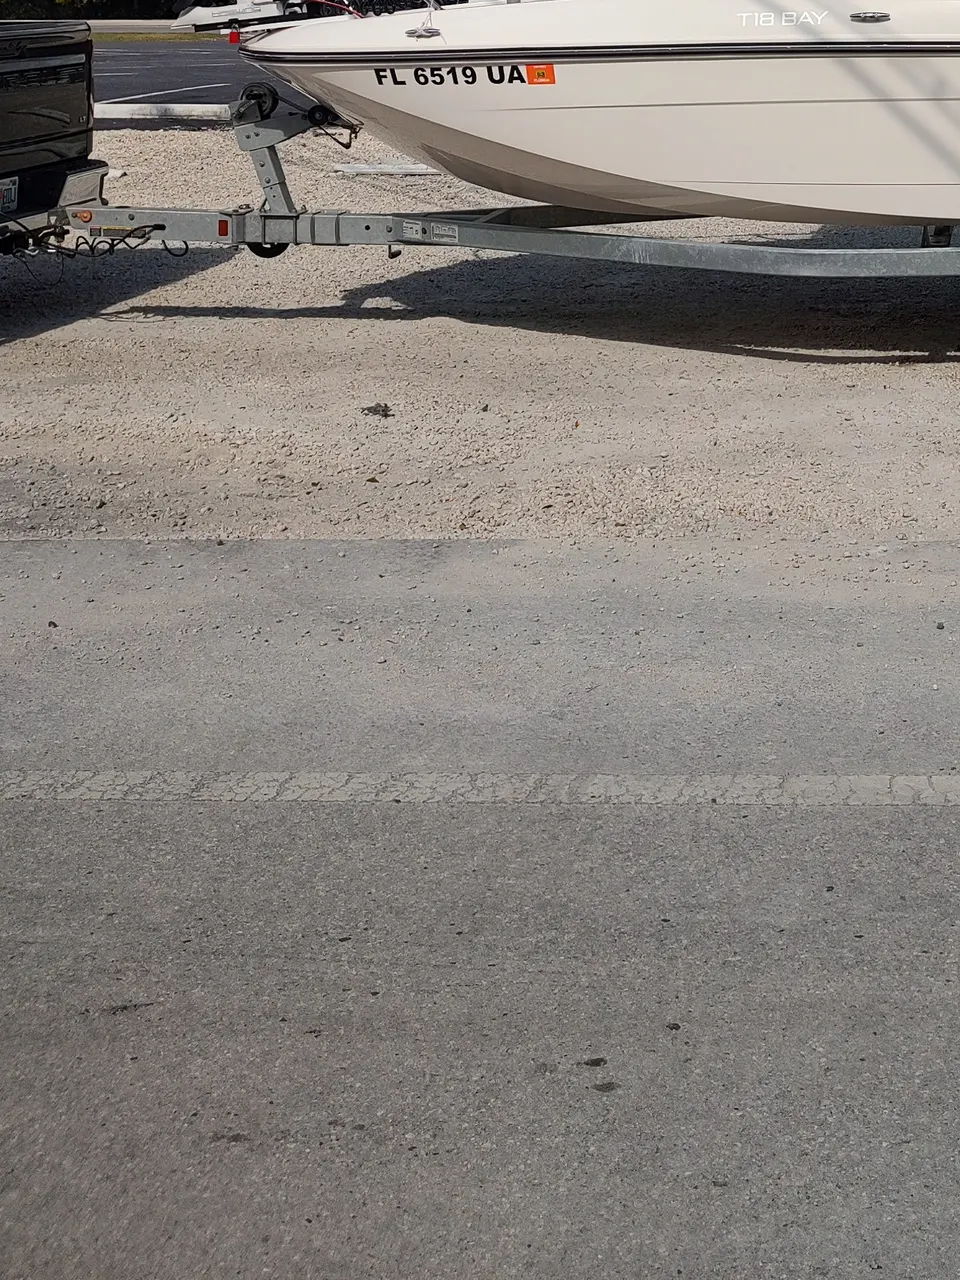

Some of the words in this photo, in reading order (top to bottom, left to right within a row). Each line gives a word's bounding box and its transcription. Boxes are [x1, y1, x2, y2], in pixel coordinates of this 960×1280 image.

[736, 12, 775, 27] T18
[781, 10, 829, 26] BAY
[373, 67, 407, 85] FL
[413, 66, 477, 85] 6519
[486, 64, 526, 85] UA
